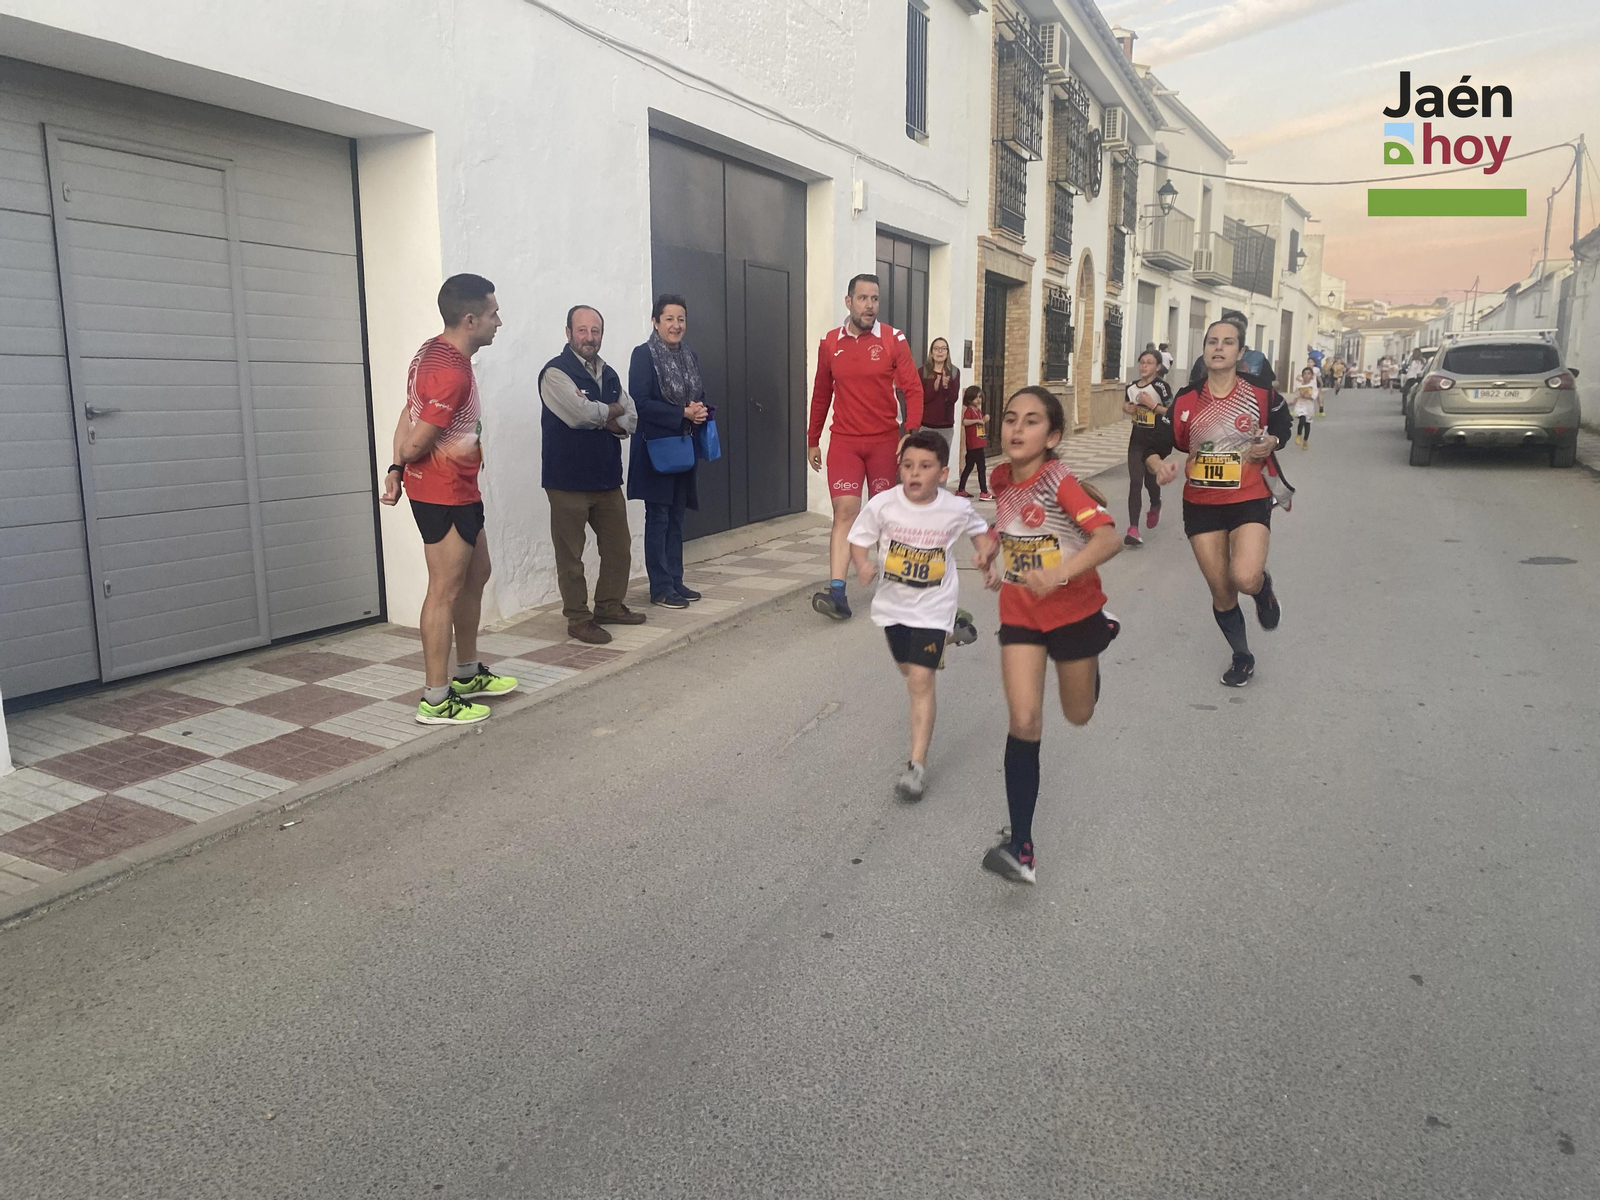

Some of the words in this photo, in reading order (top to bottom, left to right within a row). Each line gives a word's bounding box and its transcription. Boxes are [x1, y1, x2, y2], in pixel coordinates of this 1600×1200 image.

[1480, 390, 1500, 398] 9822
[1504, 390, 1520, 398] GNB
[1204, 465, 1224, 479] 114
[901, 560, 930, 580] 318
